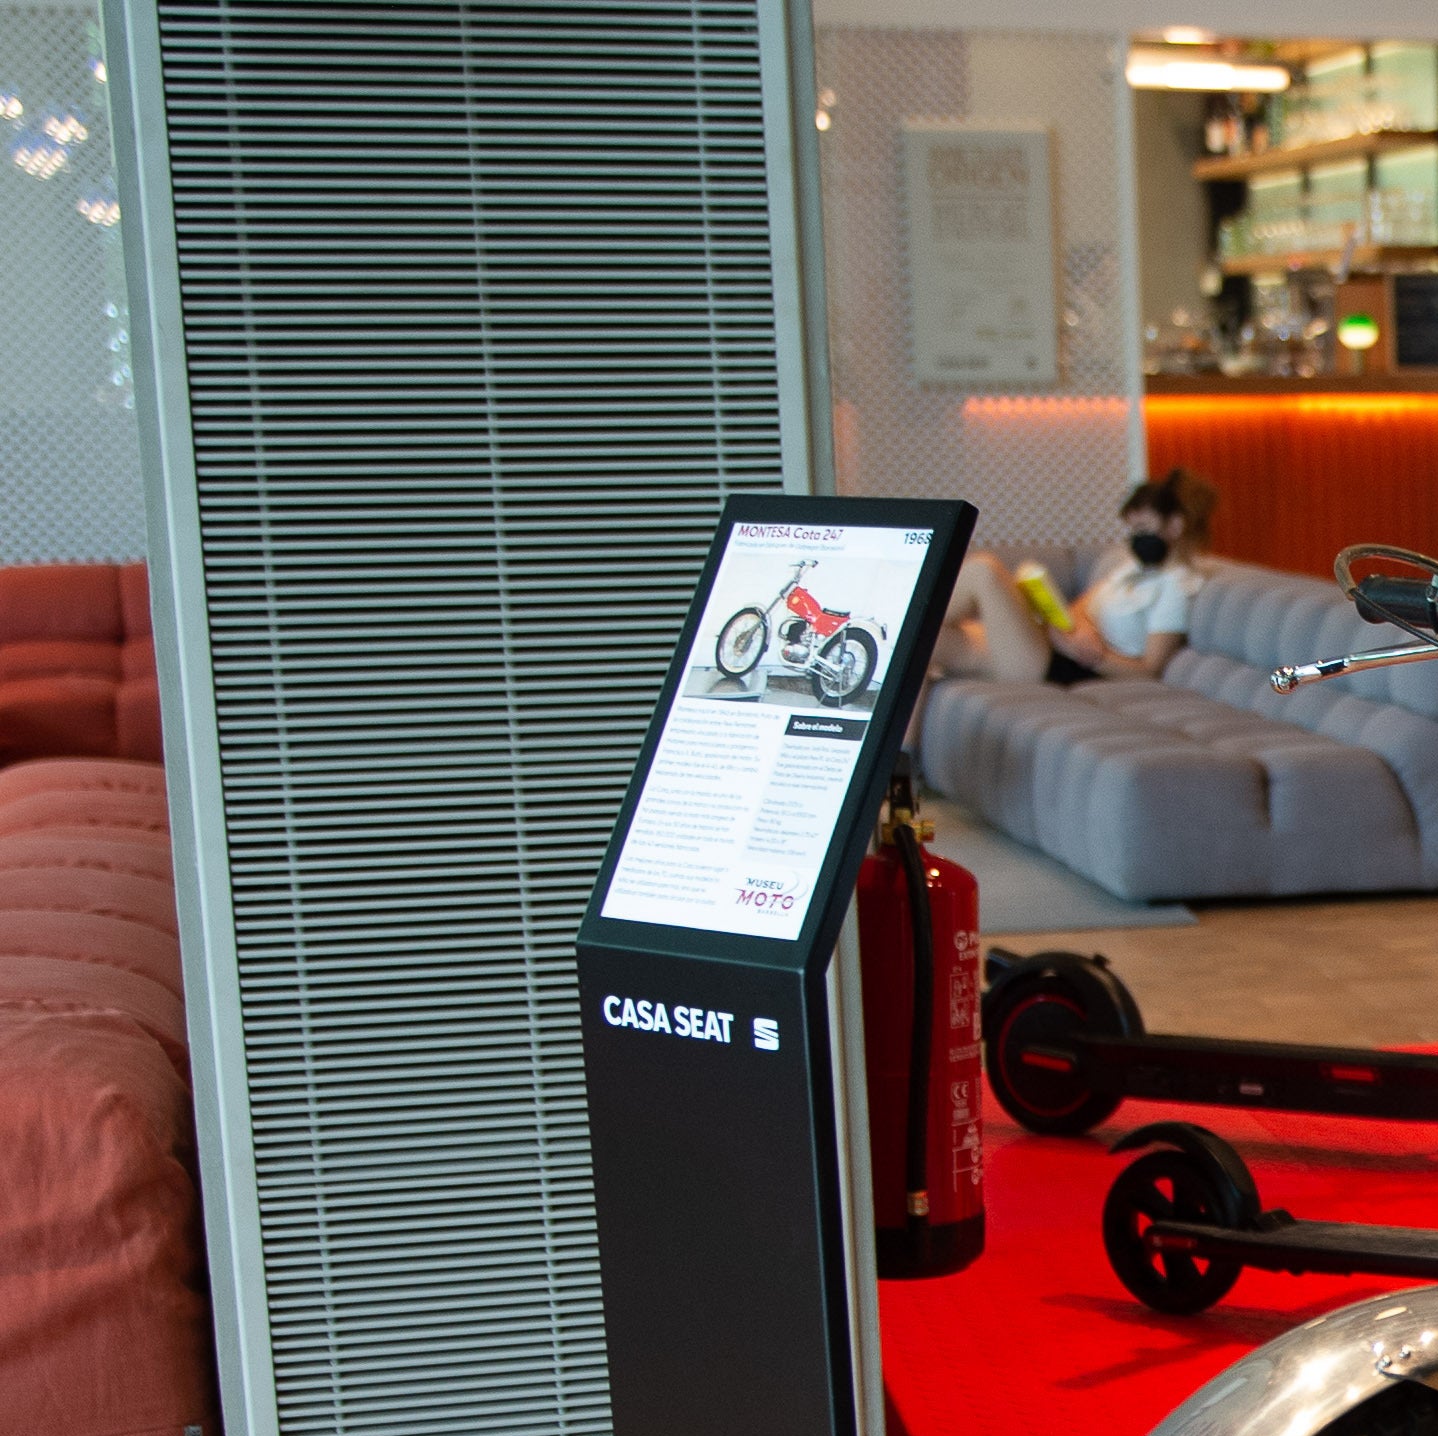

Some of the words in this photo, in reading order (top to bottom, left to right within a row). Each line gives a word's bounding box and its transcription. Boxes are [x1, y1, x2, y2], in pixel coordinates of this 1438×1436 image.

[737, 525, 791, 539] MONTESA
[793, 527, 821, 541] Cota
[822, 528, 845, 541] 247
[746, 877, 785, 891] MUSEU
[735, 888, 796, 911] MOTO
[603, 995, 672, 1035] CASA
[673, 1005, 735, 1044] SEAT
